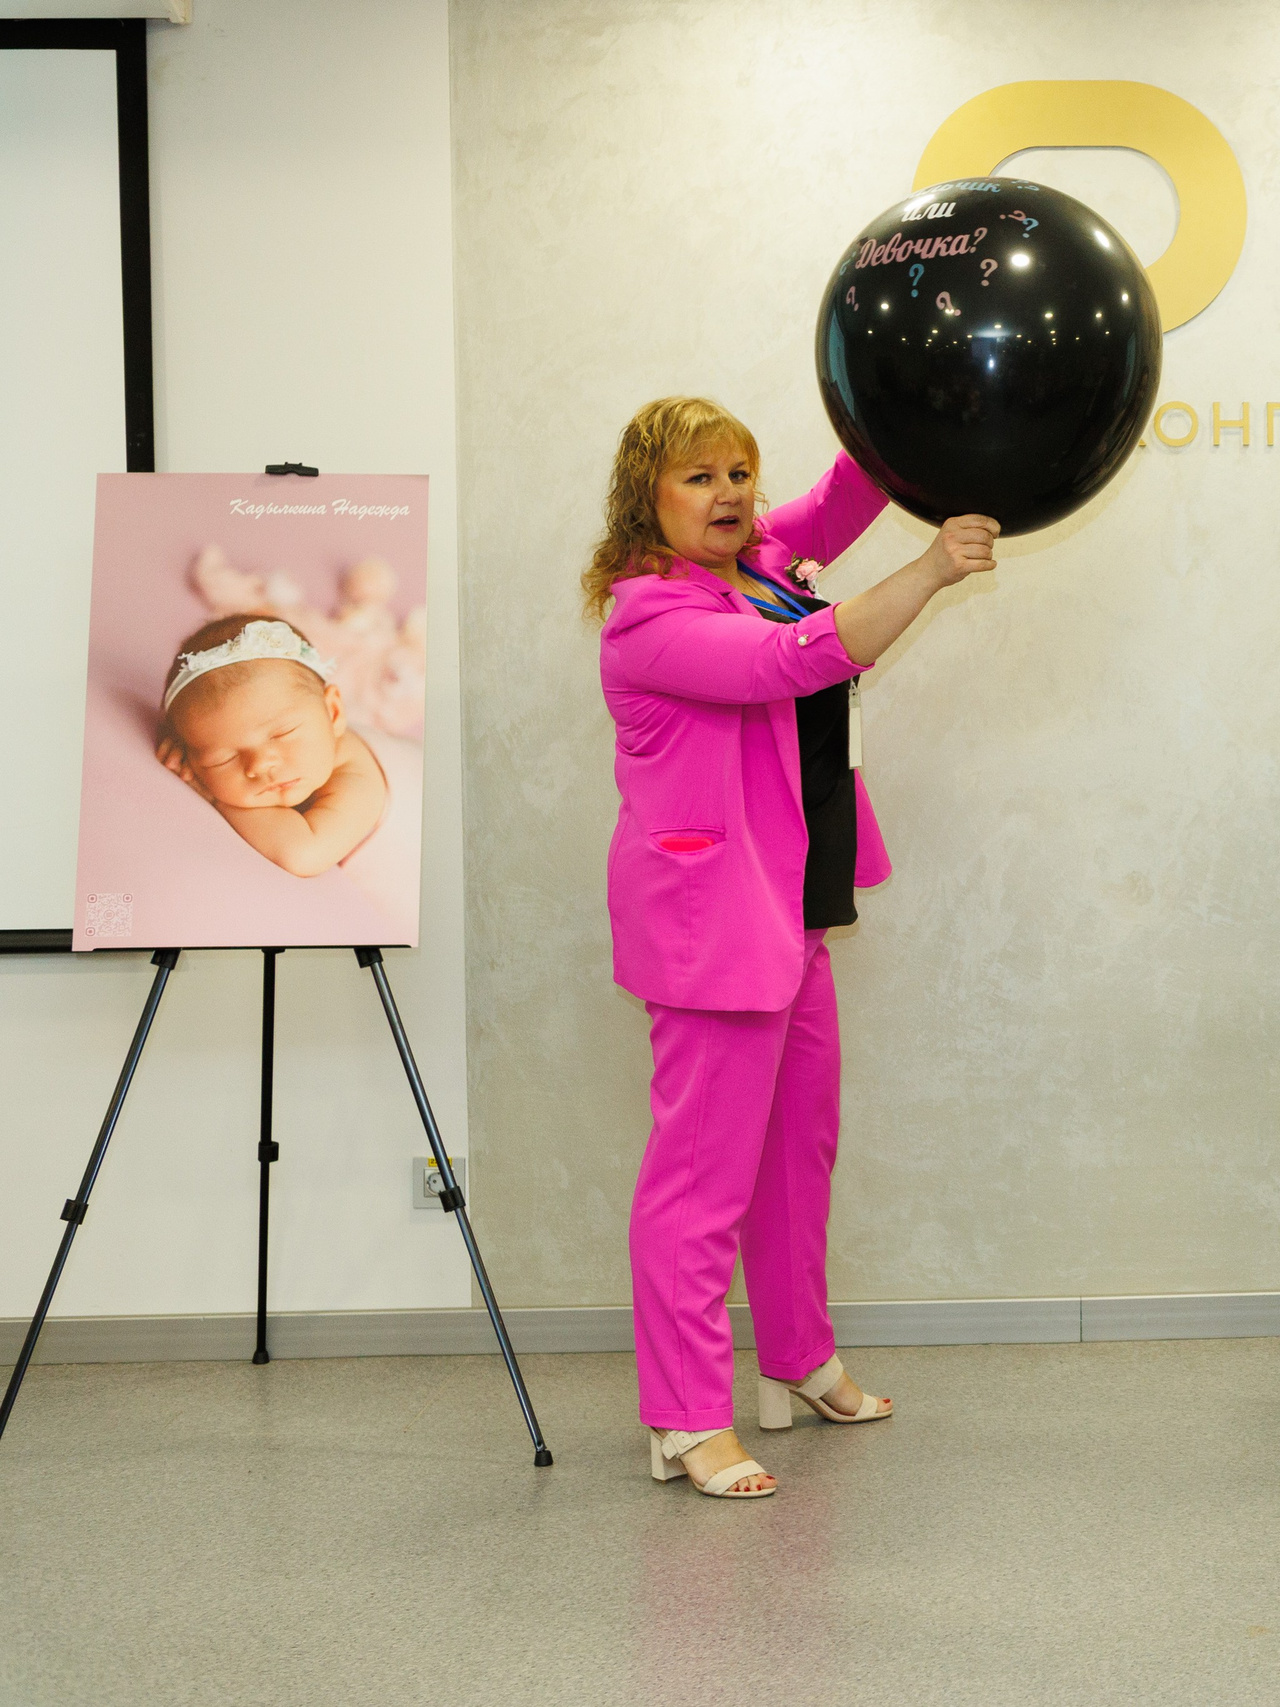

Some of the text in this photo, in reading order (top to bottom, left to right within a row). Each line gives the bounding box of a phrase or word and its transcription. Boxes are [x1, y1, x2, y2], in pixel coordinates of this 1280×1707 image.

[901, 202, 956, 222] или
[855, 227, 987, 269] Девочка?
[331, 498, 410, 520] Надежда
